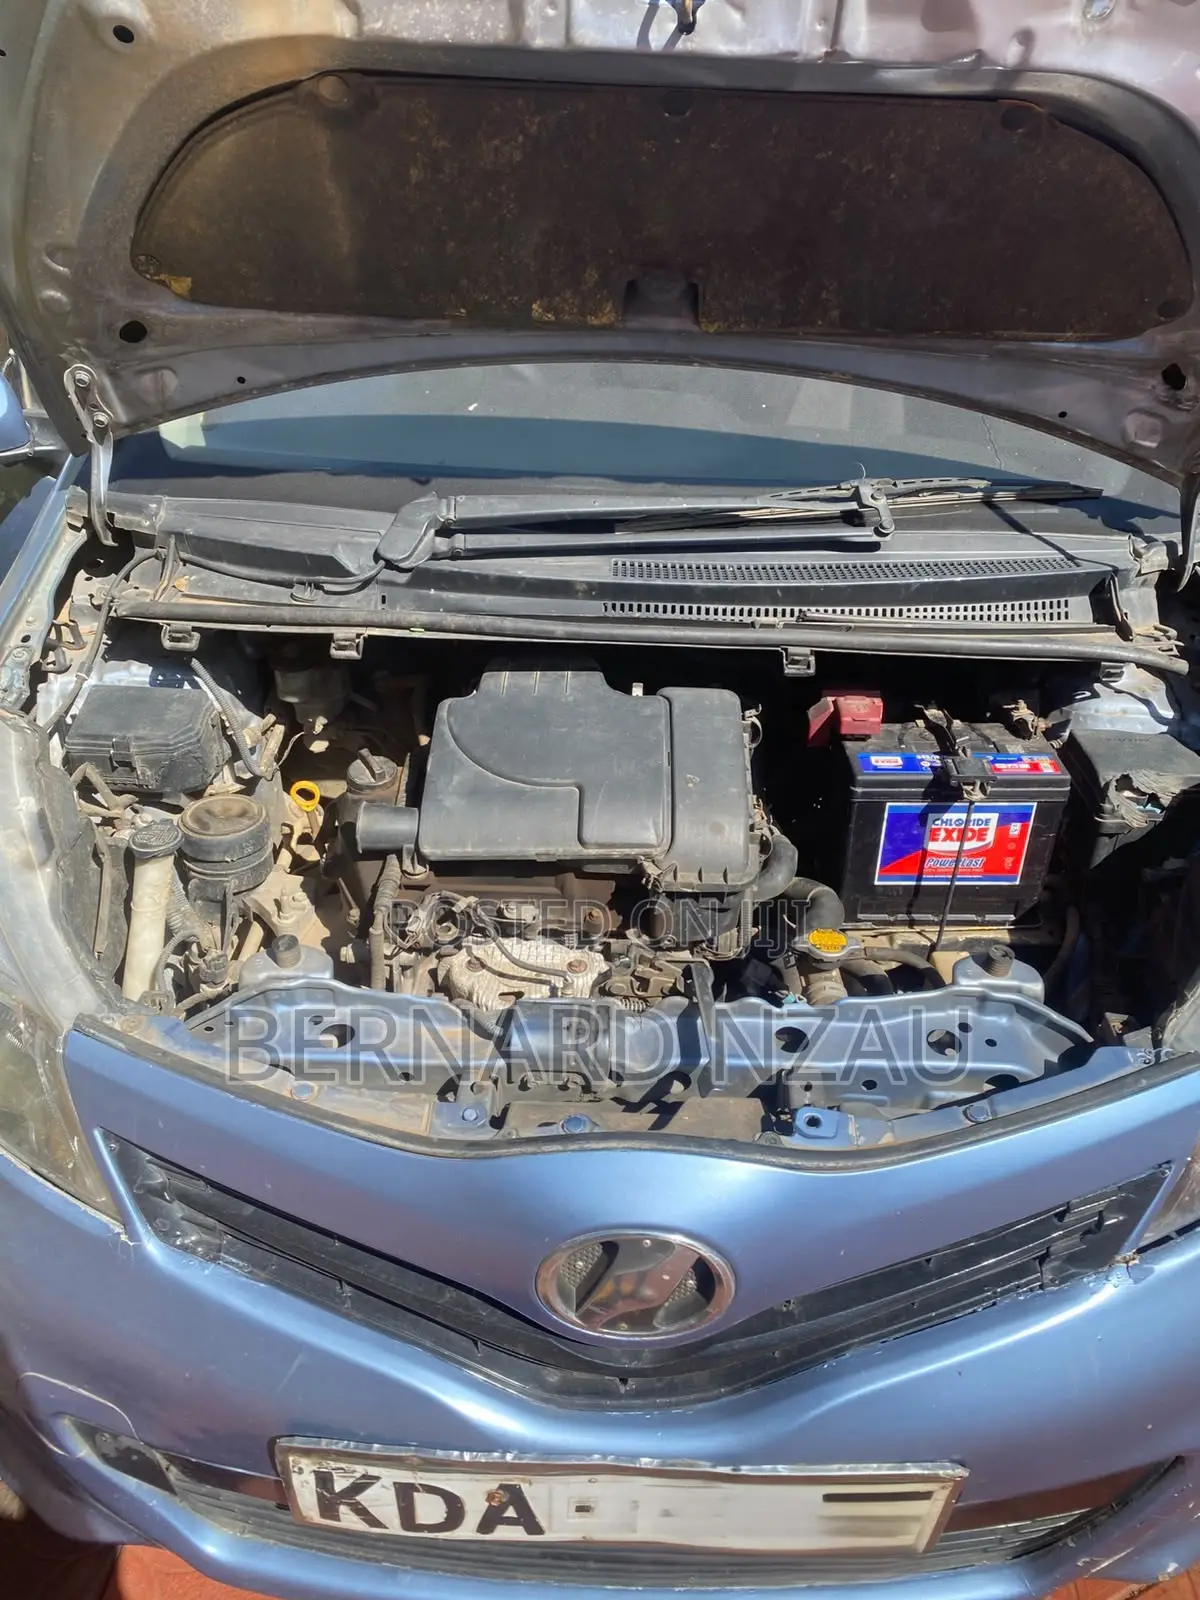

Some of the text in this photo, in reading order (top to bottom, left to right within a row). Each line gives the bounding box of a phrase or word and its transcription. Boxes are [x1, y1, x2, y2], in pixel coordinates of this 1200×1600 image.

[932, 817, 992, 827] CHLOIDE
[929, 827, 990, 842] EXIDE
[925, 857, 985, 867] PoweLast
[314, 1469, 547, 1536] KDA
